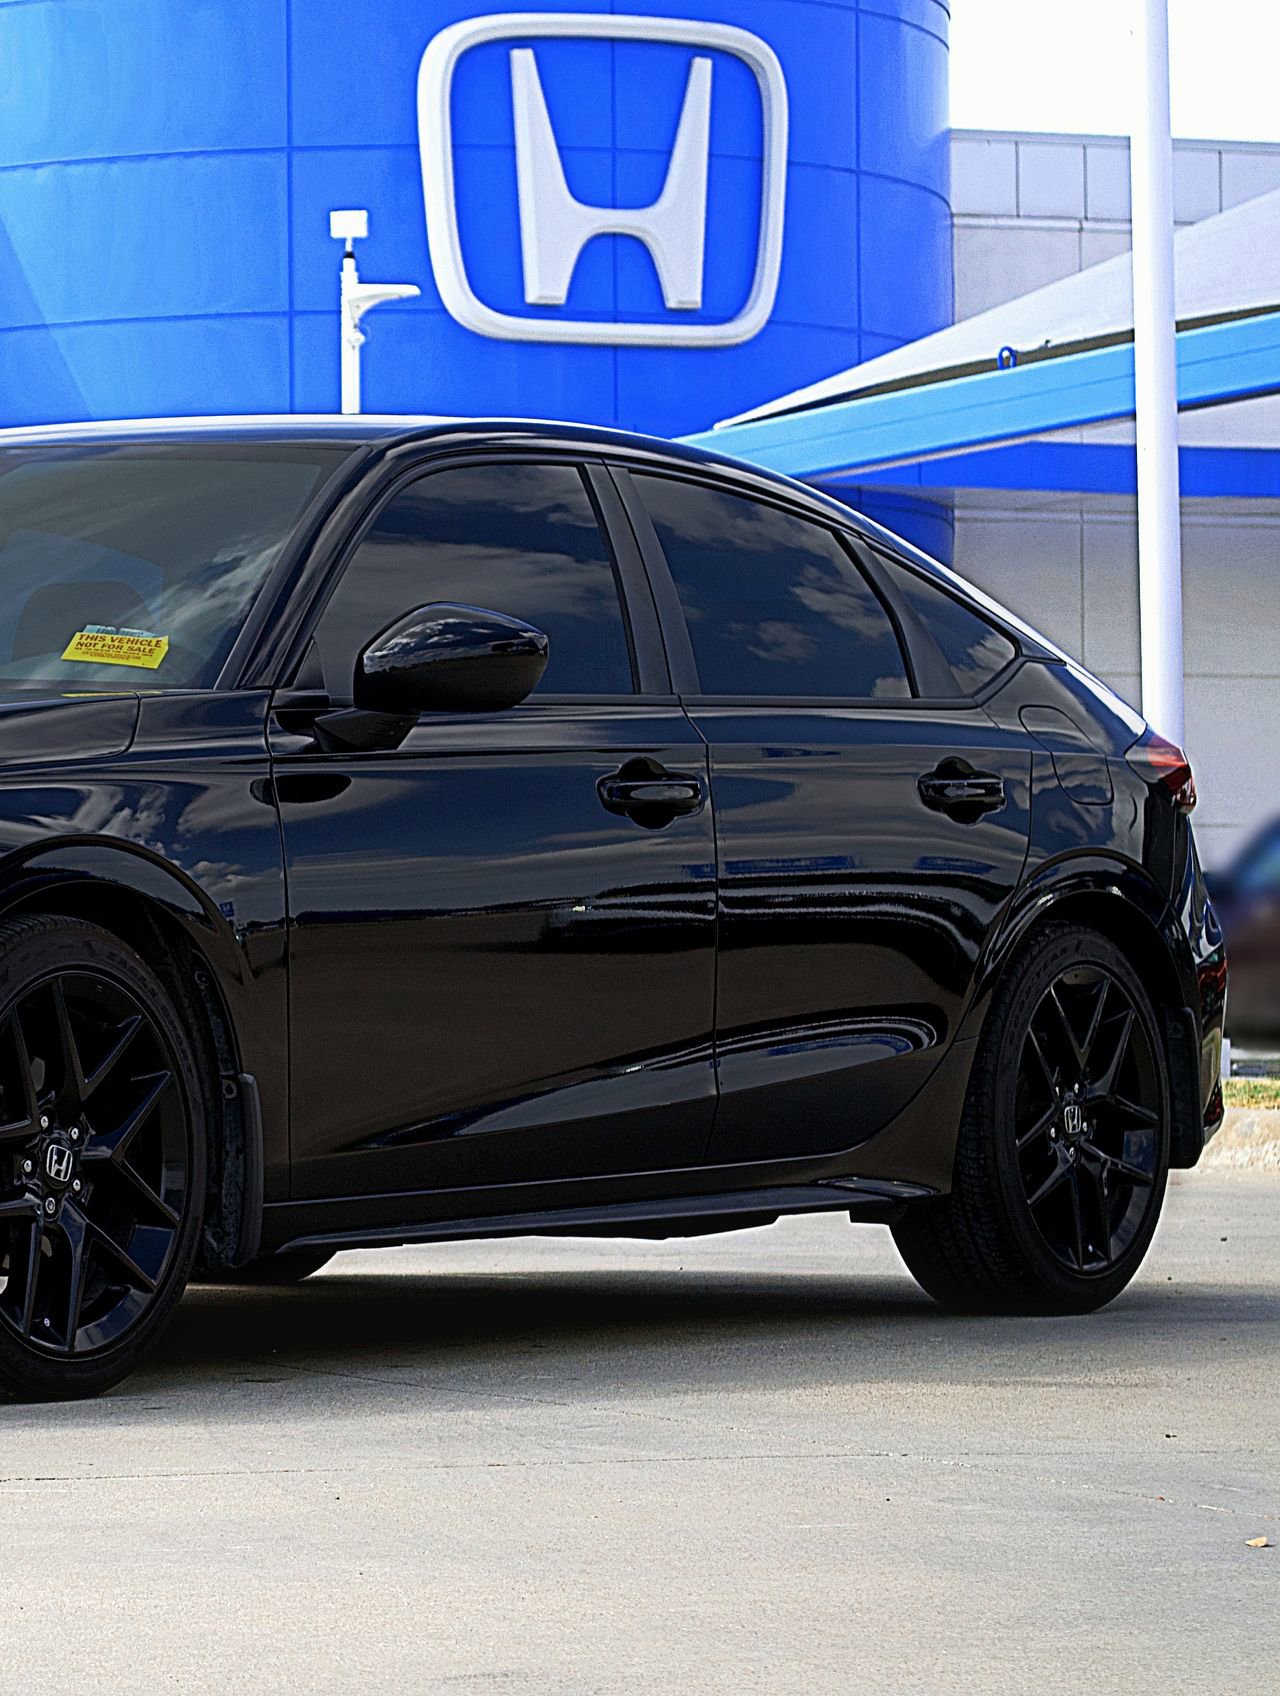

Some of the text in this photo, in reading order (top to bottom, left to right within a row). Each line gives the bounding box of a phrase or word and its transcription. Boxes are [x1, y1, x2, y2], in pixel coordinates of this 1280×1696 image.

[78, 633, 107, 642] THIS
[110, 635, 162, 648] VEHICLE
[101, 643, 124, 651] FOR
[127, 646, 157, 655] SALE
